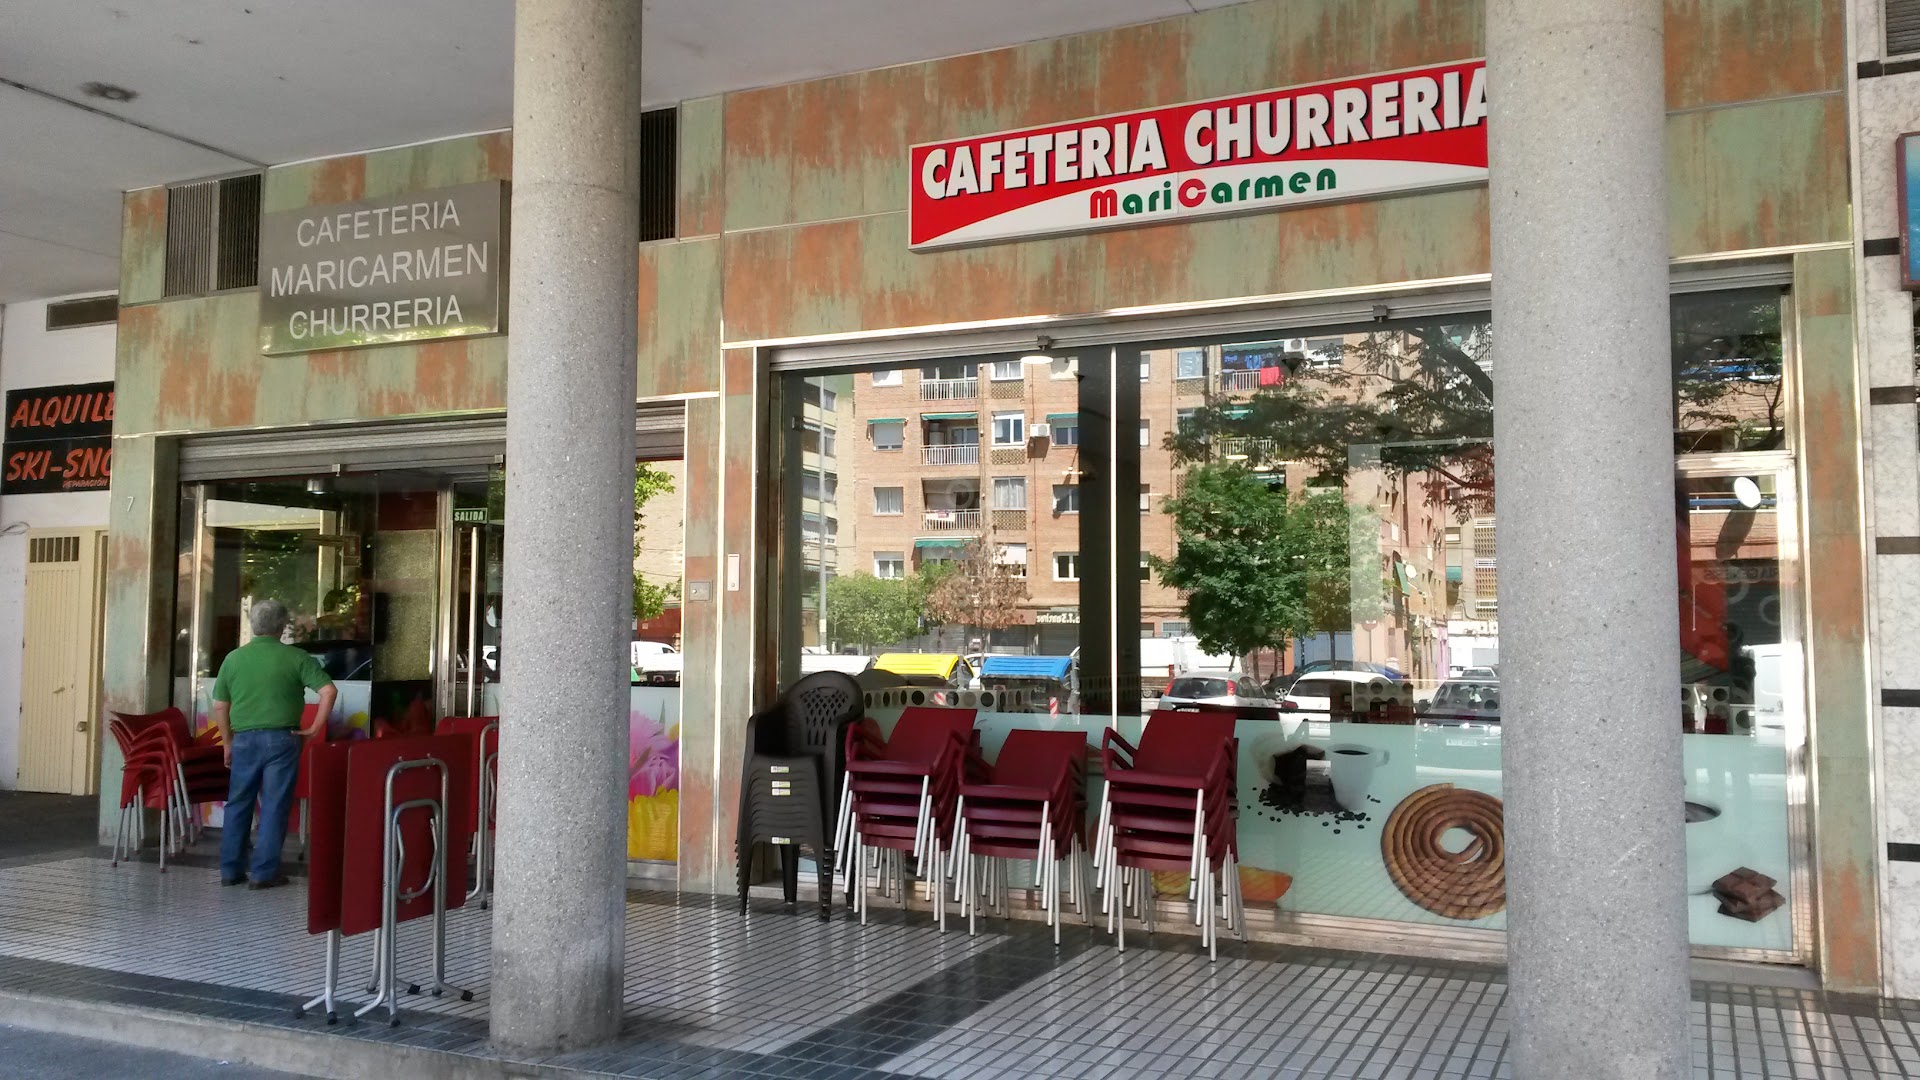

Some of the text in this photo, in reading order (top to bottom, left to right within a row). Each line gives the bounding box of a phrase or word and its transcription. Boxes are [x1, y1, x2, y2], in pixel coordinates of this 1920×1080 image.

[921, 66, 1488, 200] CAFETERIA CHURRERIA
[296, 199, 460, 247] CAFETERIA
[270, 241, 488, 298] MARICARMEN
[289, 294, 464, 340] CHURRERIA
[126, 495, 135, 512] 7
[454, 510, 484, 521] SALIDA
